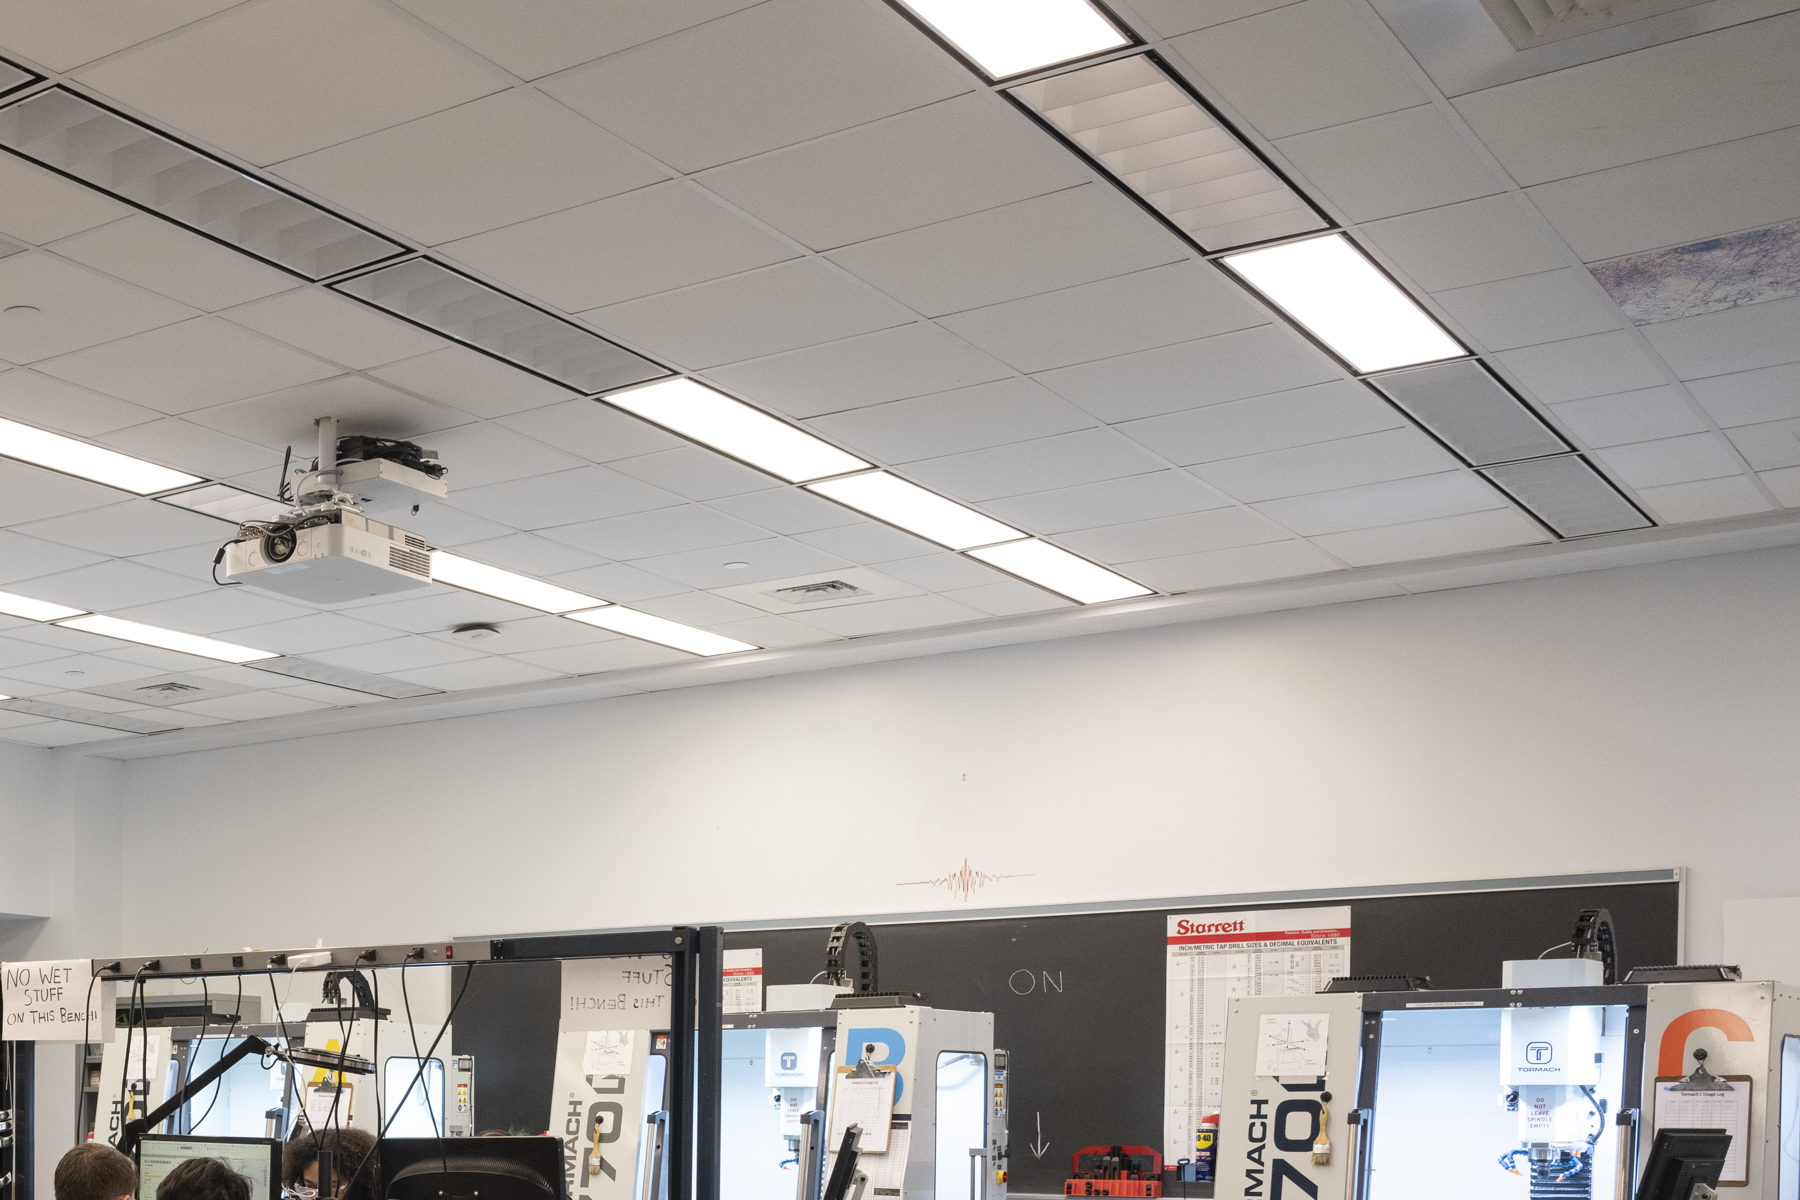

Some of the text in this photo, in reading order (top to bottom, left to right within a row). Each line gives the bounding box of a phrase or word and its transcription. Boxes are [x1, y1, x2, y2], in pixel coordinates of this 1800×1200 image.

[1176, 919, 1244, 935] Starrett
[6, 966, 72, 990] NO WET
[1009, 968, 1062, 995] ON
[24, 987, 63, 1006] STUFF
[7, 1008, 98, 1025] ON THIS BENCH!
[845, 1028, 906, 1107] B
